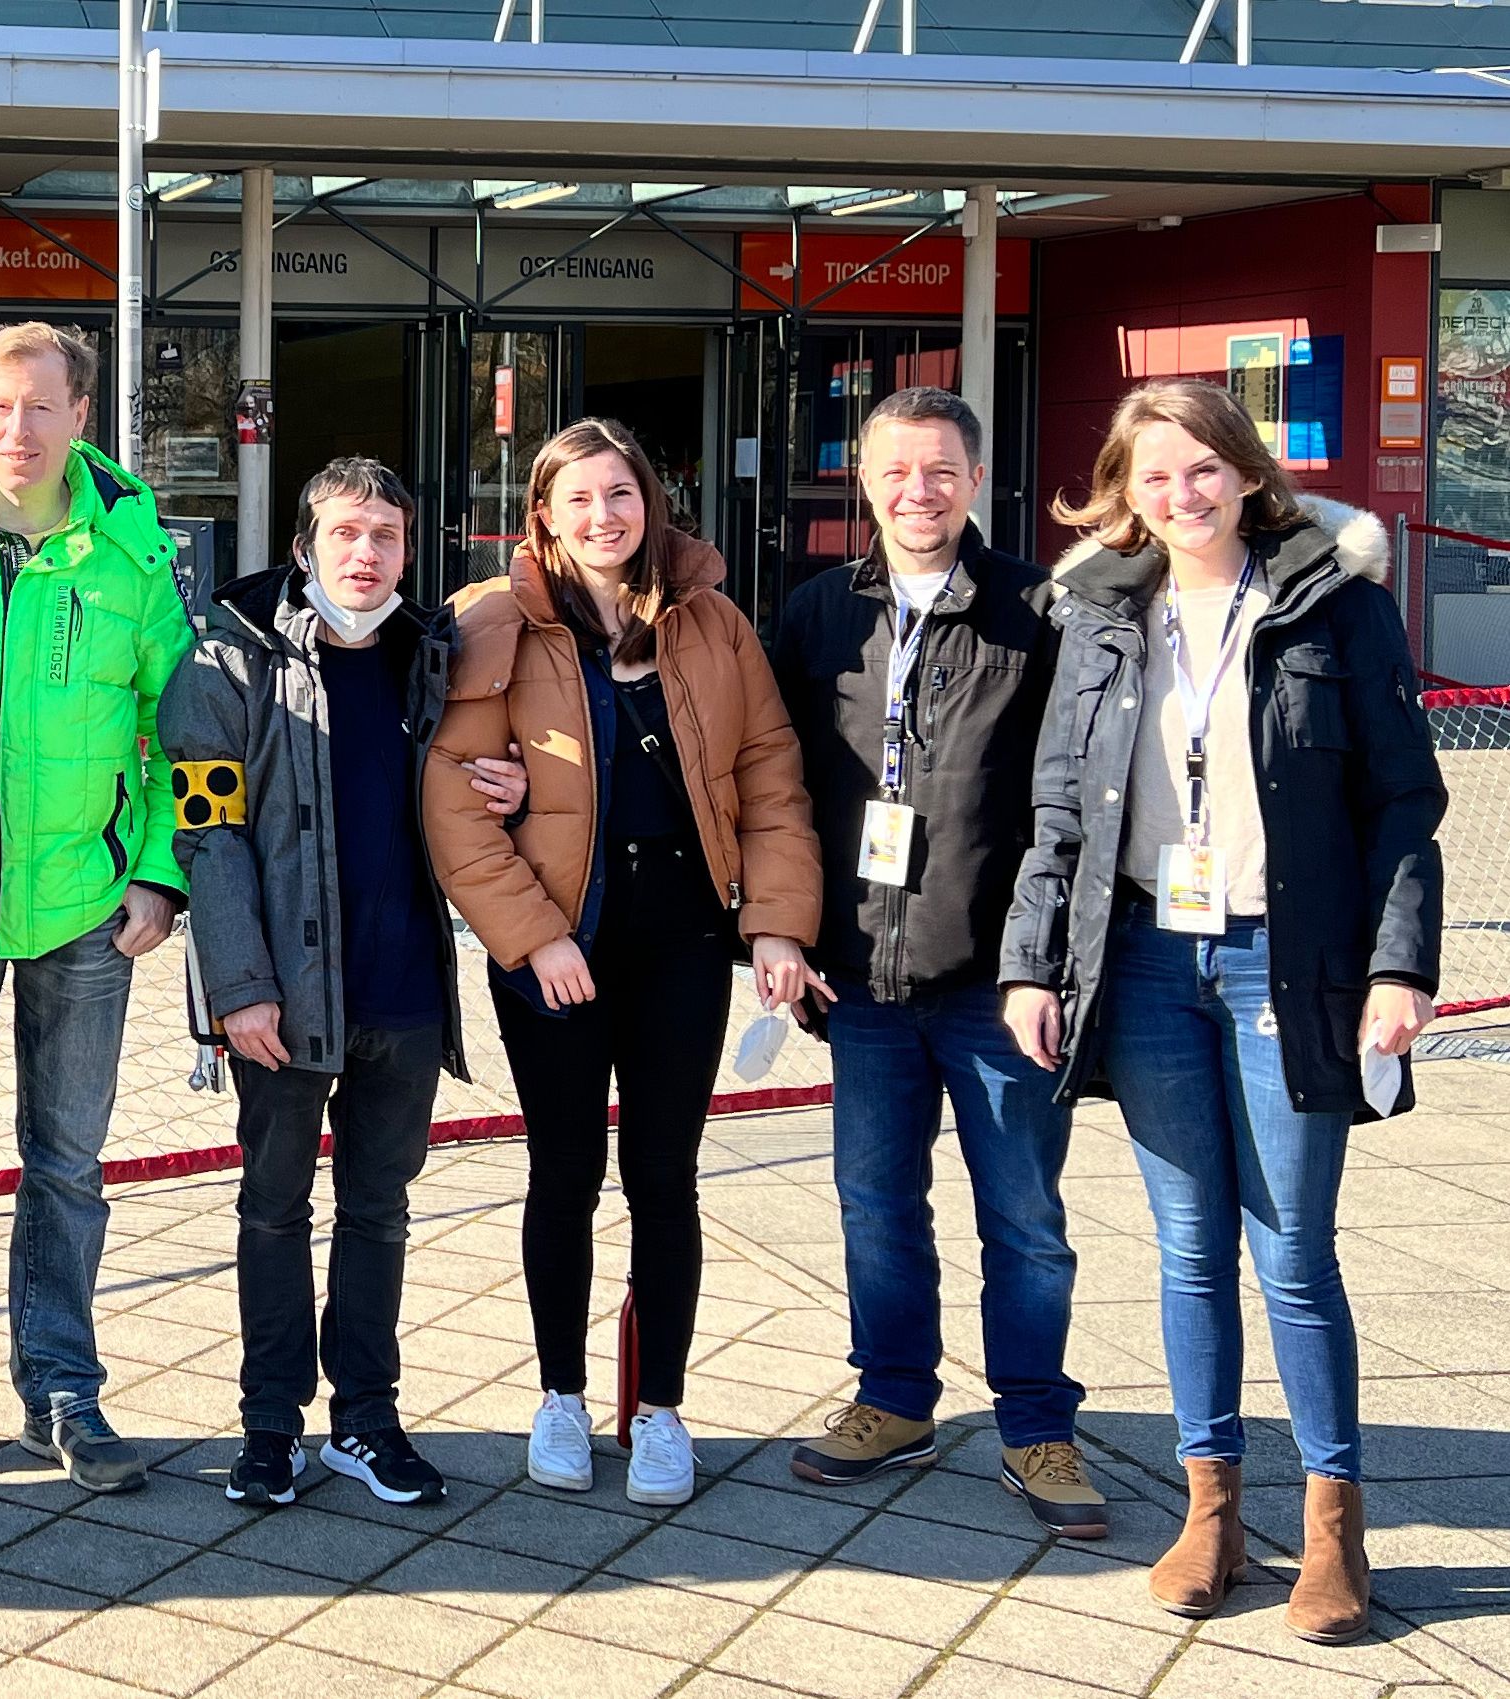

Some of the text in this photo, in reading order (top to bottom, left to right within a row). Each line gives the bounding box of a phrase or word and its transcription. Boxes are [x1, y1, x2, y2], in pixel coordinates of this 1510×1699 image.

[519, 256, 654, 279] OST-EINGANG
[824, 262, 951, 285] TICKET-SHOP
[50, 585, 69, 680] 2501 CAMP DAVID
